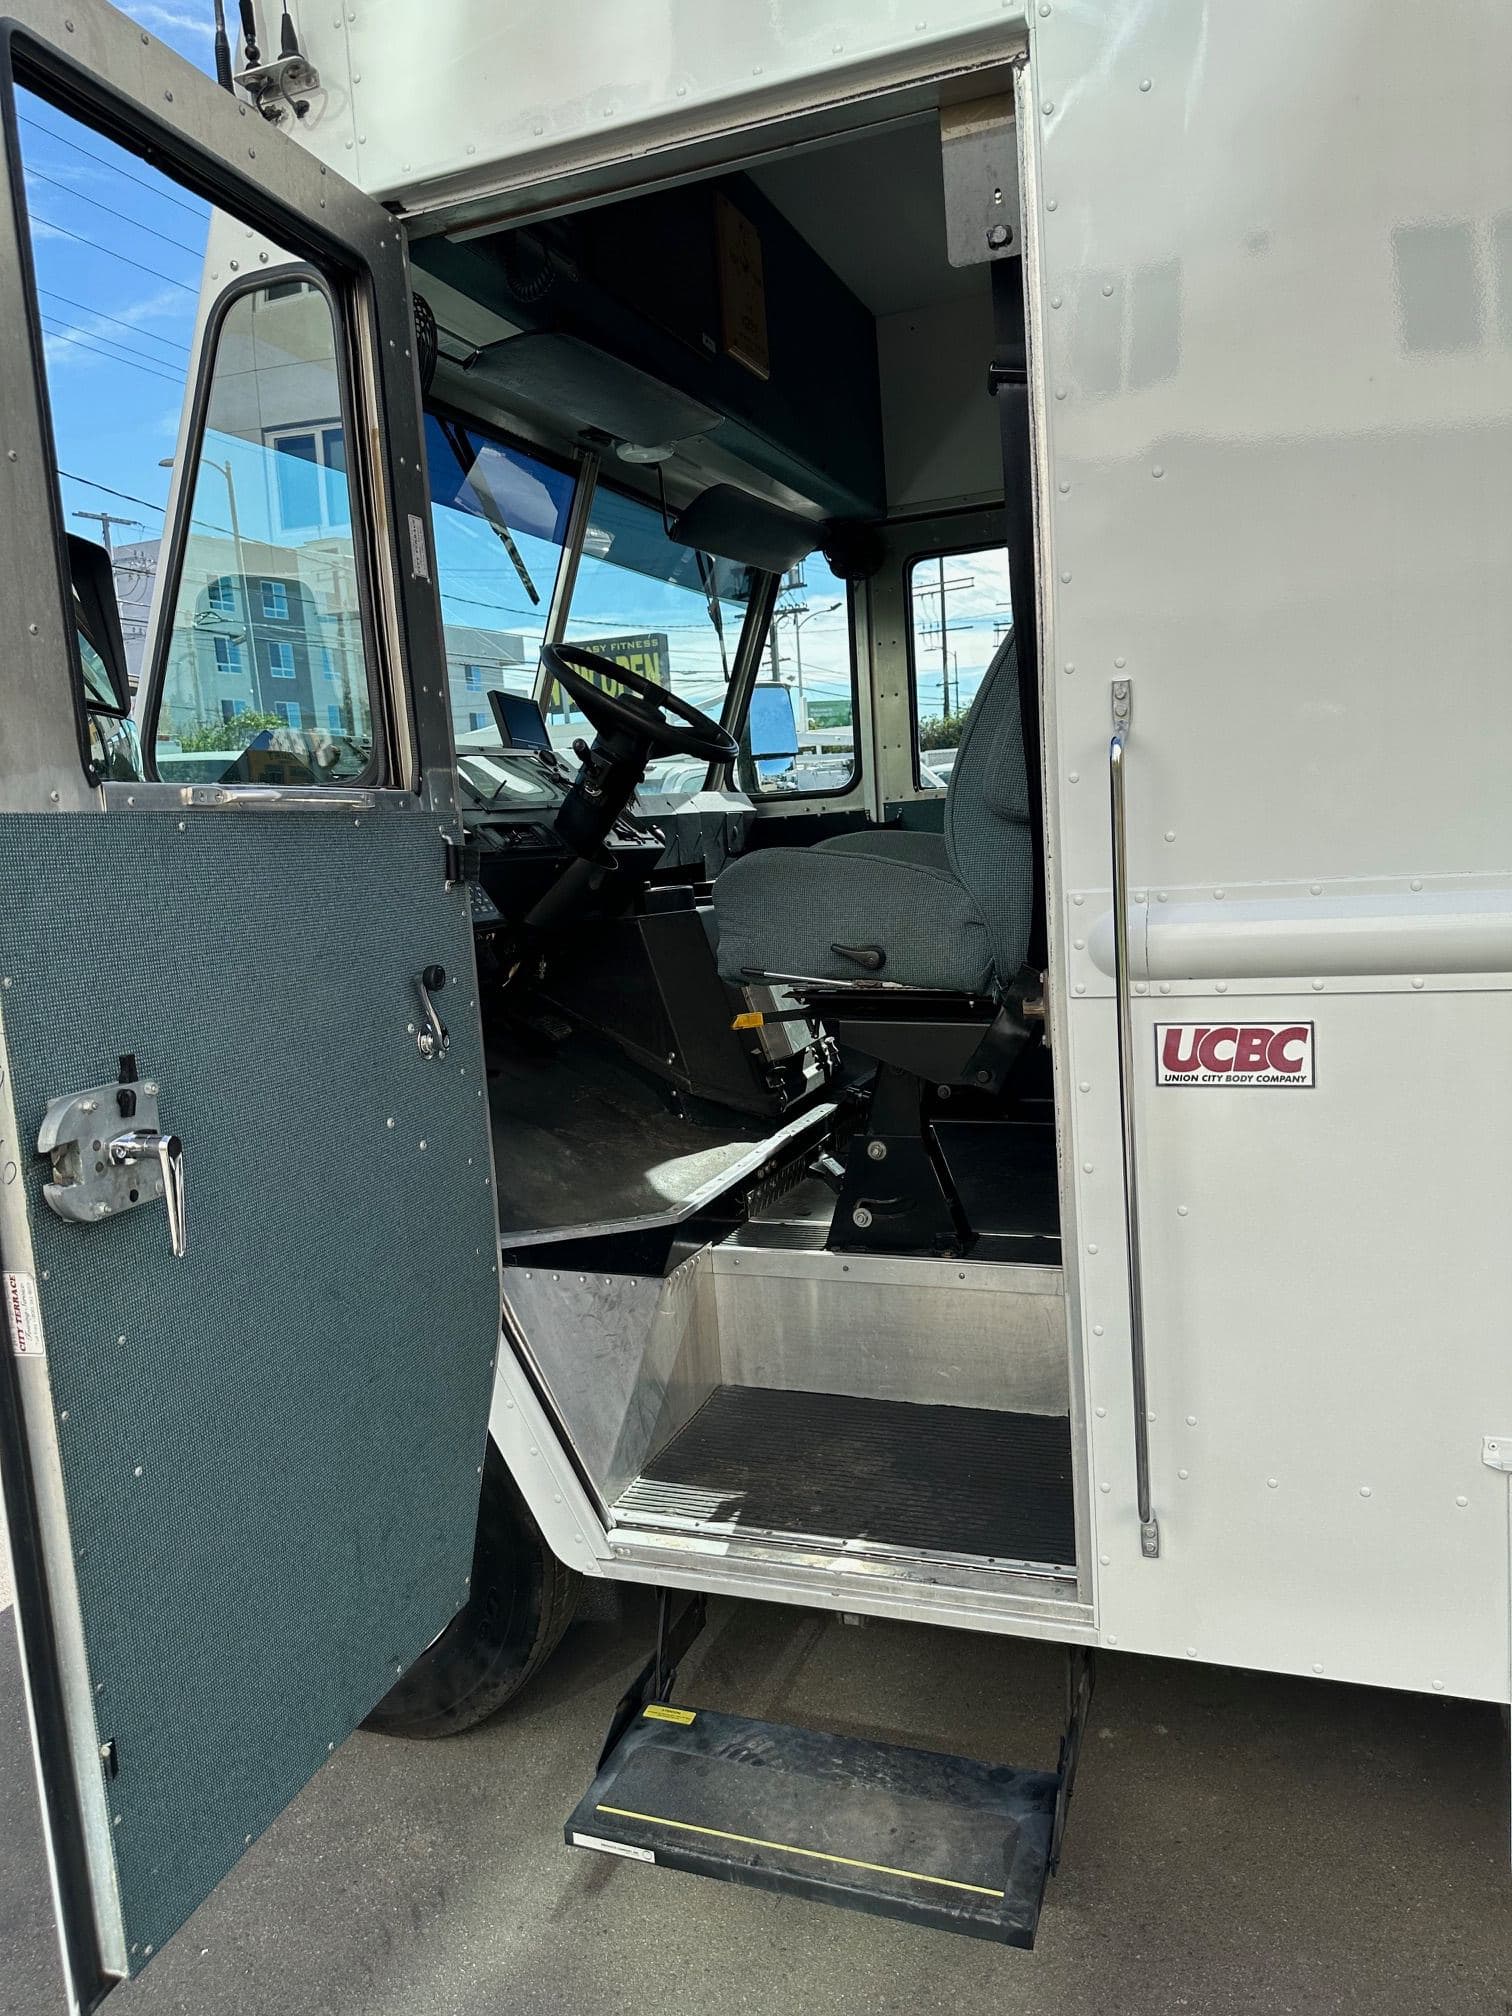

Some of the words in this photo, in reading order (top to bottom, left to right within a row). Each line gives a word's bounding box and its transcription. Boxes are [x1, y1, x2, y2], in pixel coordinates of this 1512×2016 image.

[611, 639, 659, 651] FITNESS
[1162, 1027, 1309, 1073] UCBC
[1164, 1074, 1199, 1082] UNION
[1202, 1074, 1223, 1082] CITY
[1225, 1074, 1254, 1083] BODY
[1256, 1074, 1308, 1083] COMPANY
[9, 1274, 22, 1325] TERRACE
[17, 1326, 26, 1351] CITY
